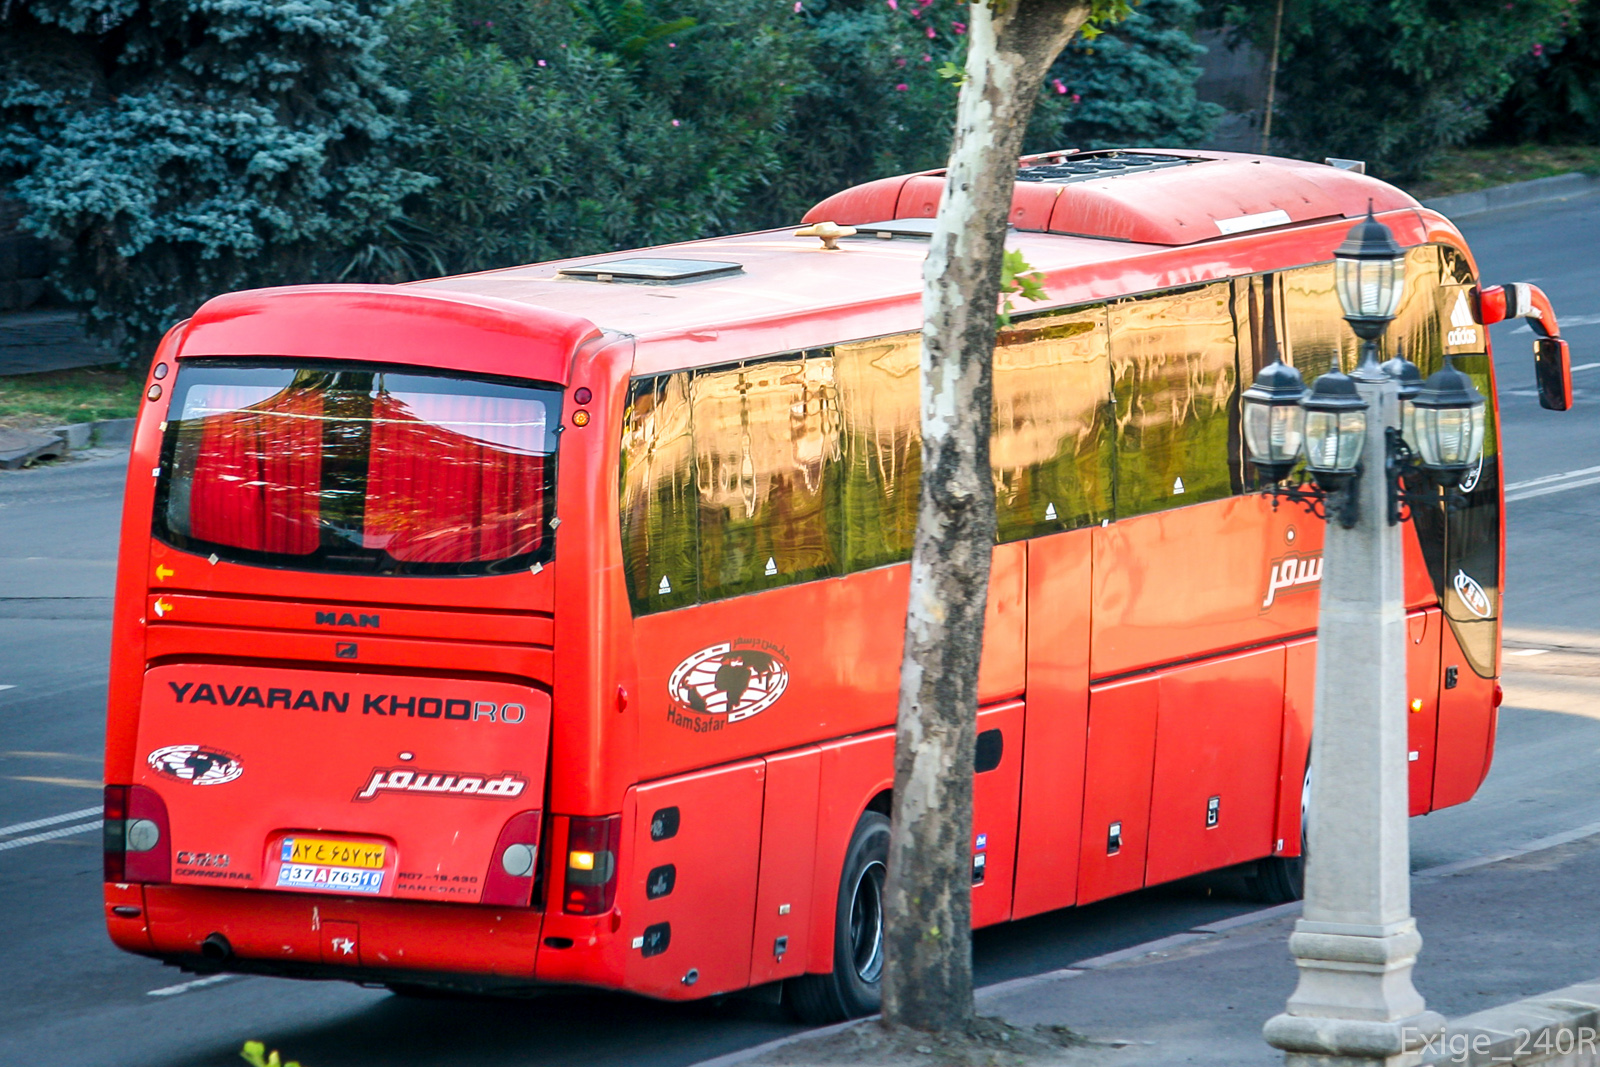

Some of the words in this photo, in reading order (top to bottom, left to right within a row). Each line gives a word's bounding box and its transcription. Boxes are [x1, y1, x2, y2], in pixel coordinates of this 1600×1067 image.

[1447, 327, 1477, 346] adidas
[1262, 529, 1325, 607] سفر
[315, 611, 380, 628] MAN
[168, 681, 350, 713] YAVARAN
[362, 693, 526, 724] KHODRO
[666, 704, 726, 733] HamSafar
[357, 751, 526, 799] همسفر
[175, 868, 227, 880] COMMON
[397, 884, 427, 892] MAN
[429, 887, 478, 895] COACH
